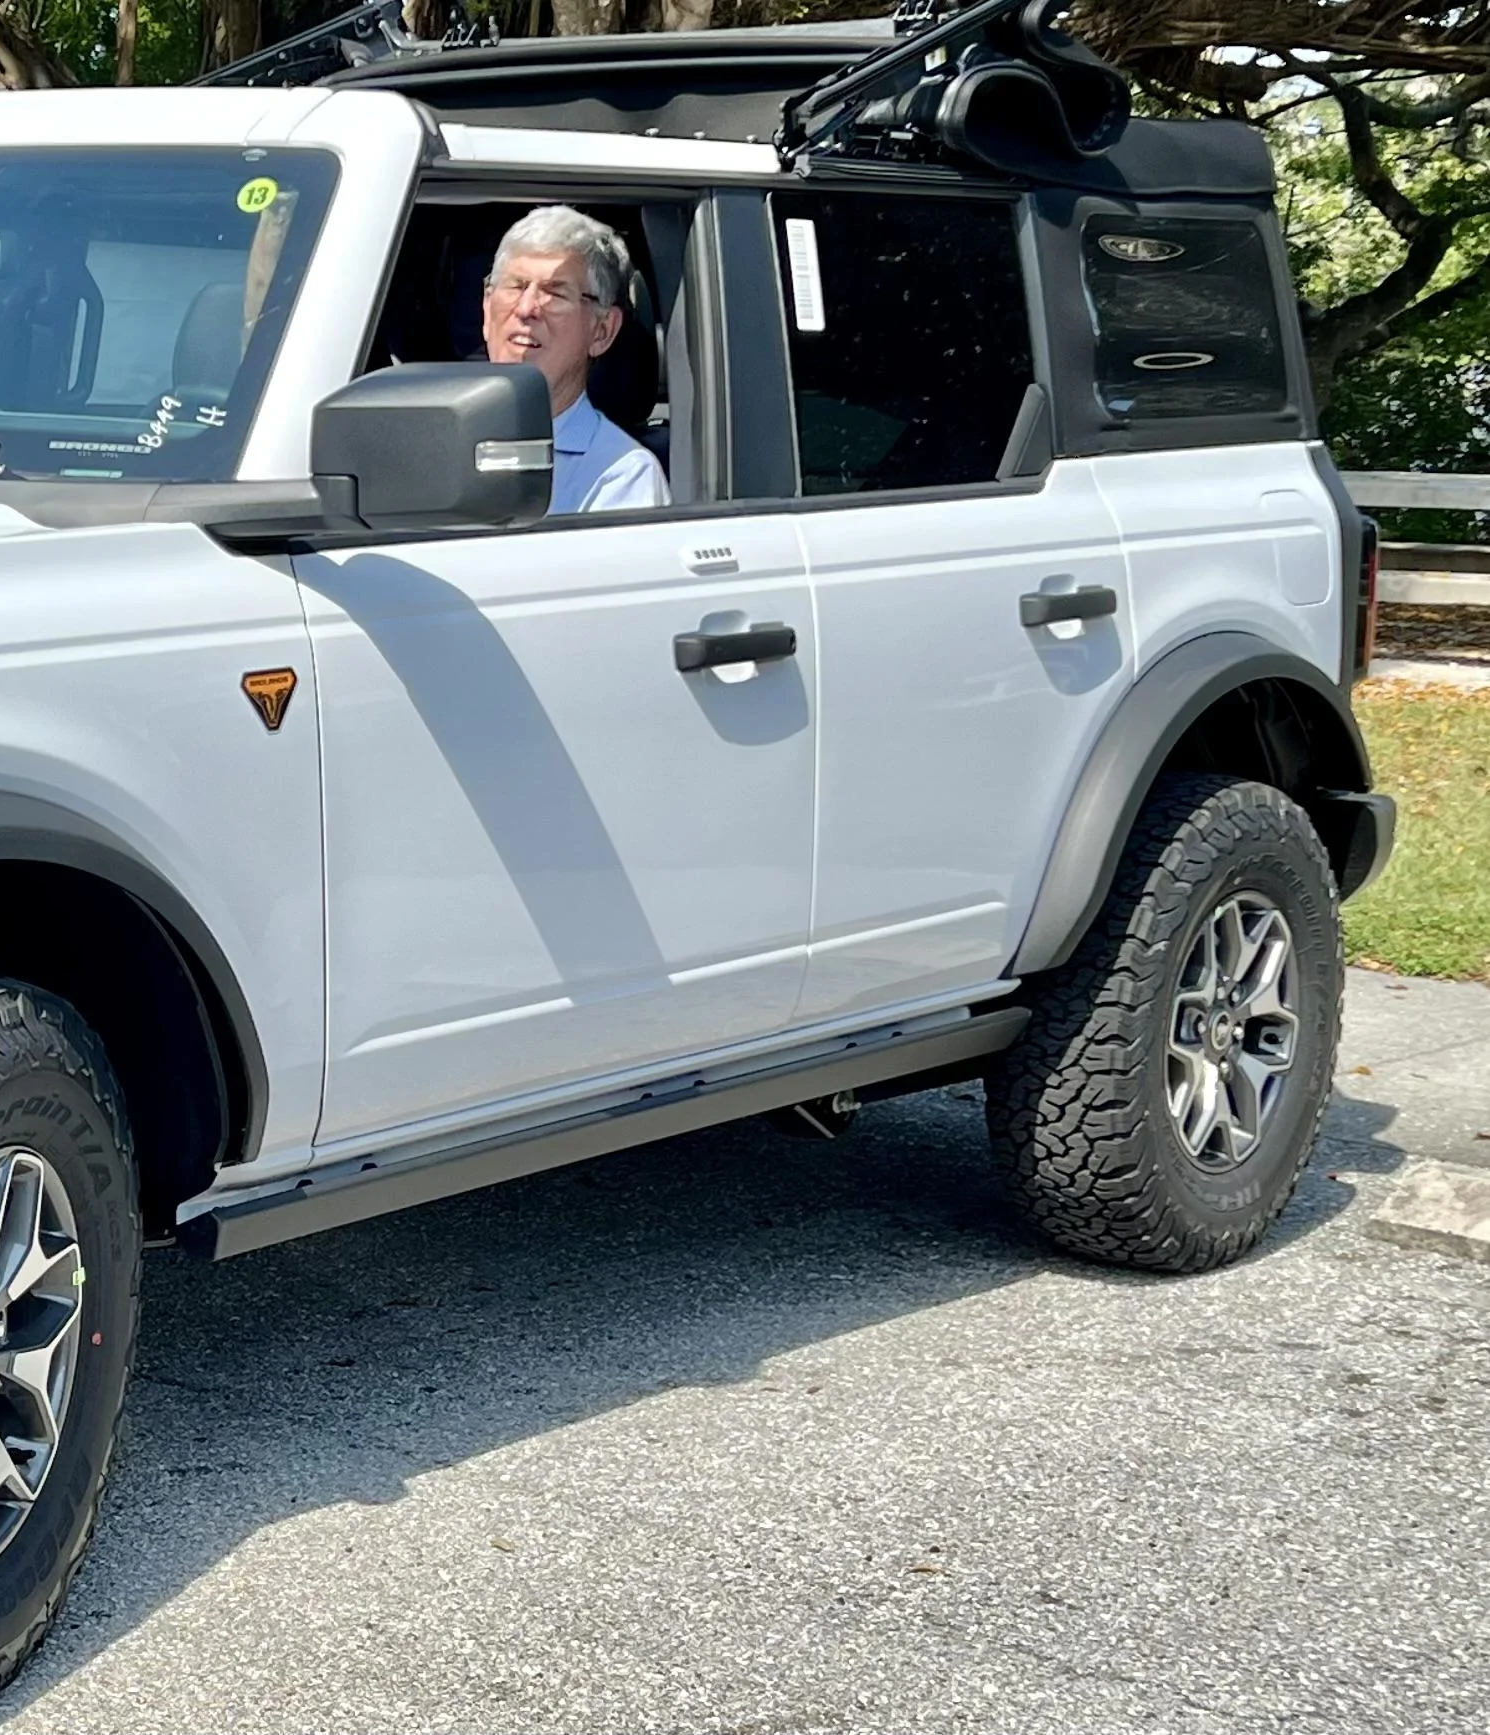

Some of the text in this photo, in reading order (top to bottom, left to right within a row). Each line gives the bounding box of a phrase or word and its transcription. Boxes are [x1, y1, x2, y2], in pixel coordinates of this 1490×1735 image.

[245, 186, 270, 206] 13
[196, 405, 227, 427] H
[48, 440, 153, 454] BRONCO
